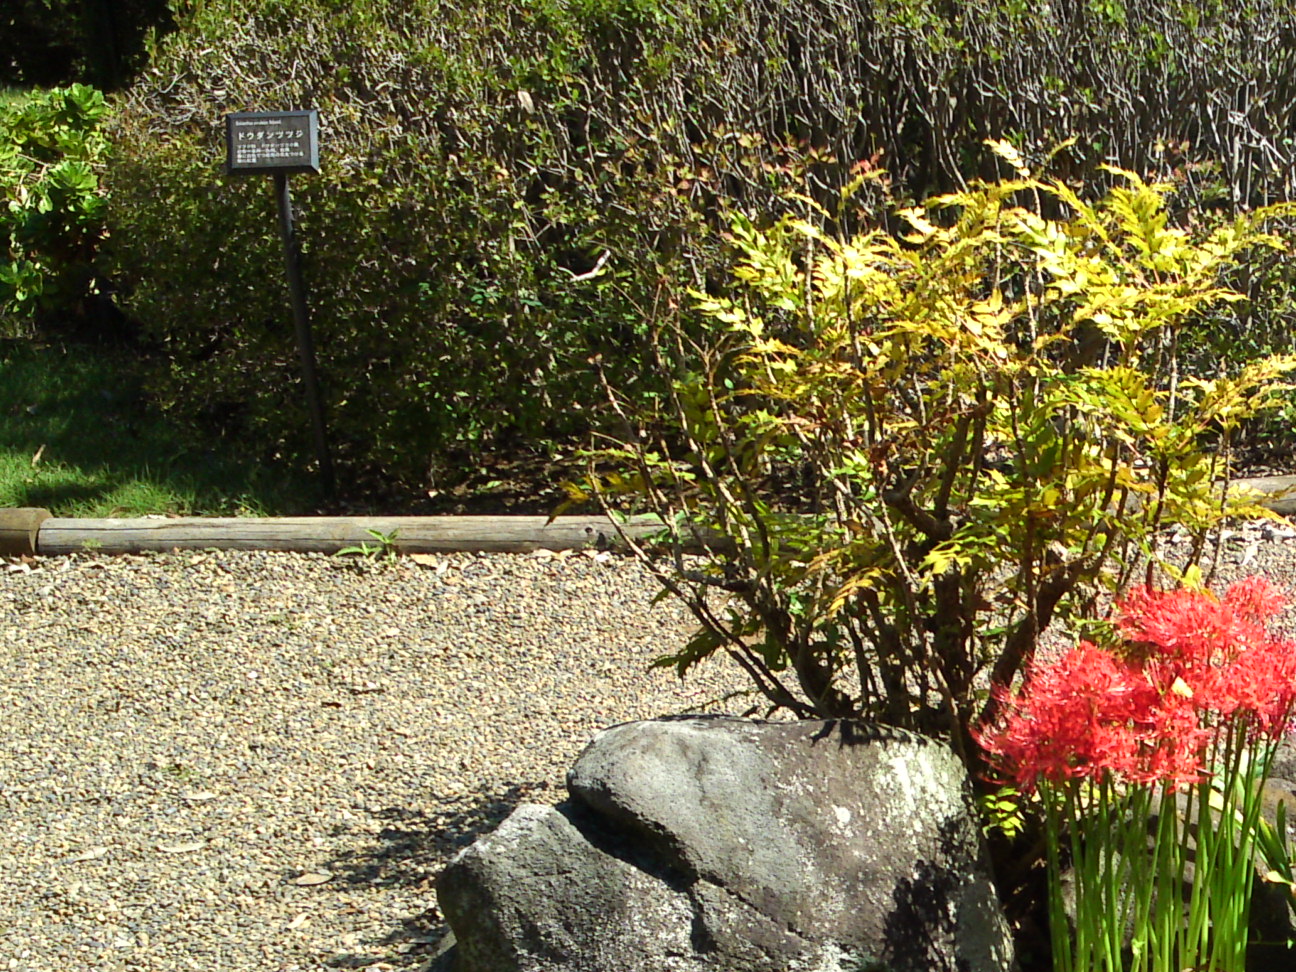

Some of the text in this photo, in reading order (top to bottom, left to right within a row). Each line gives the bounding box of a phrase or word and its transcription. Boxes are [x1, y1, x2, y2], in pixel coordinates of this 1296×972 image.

[238, 130, 303, 141] ドウダンツツジ
